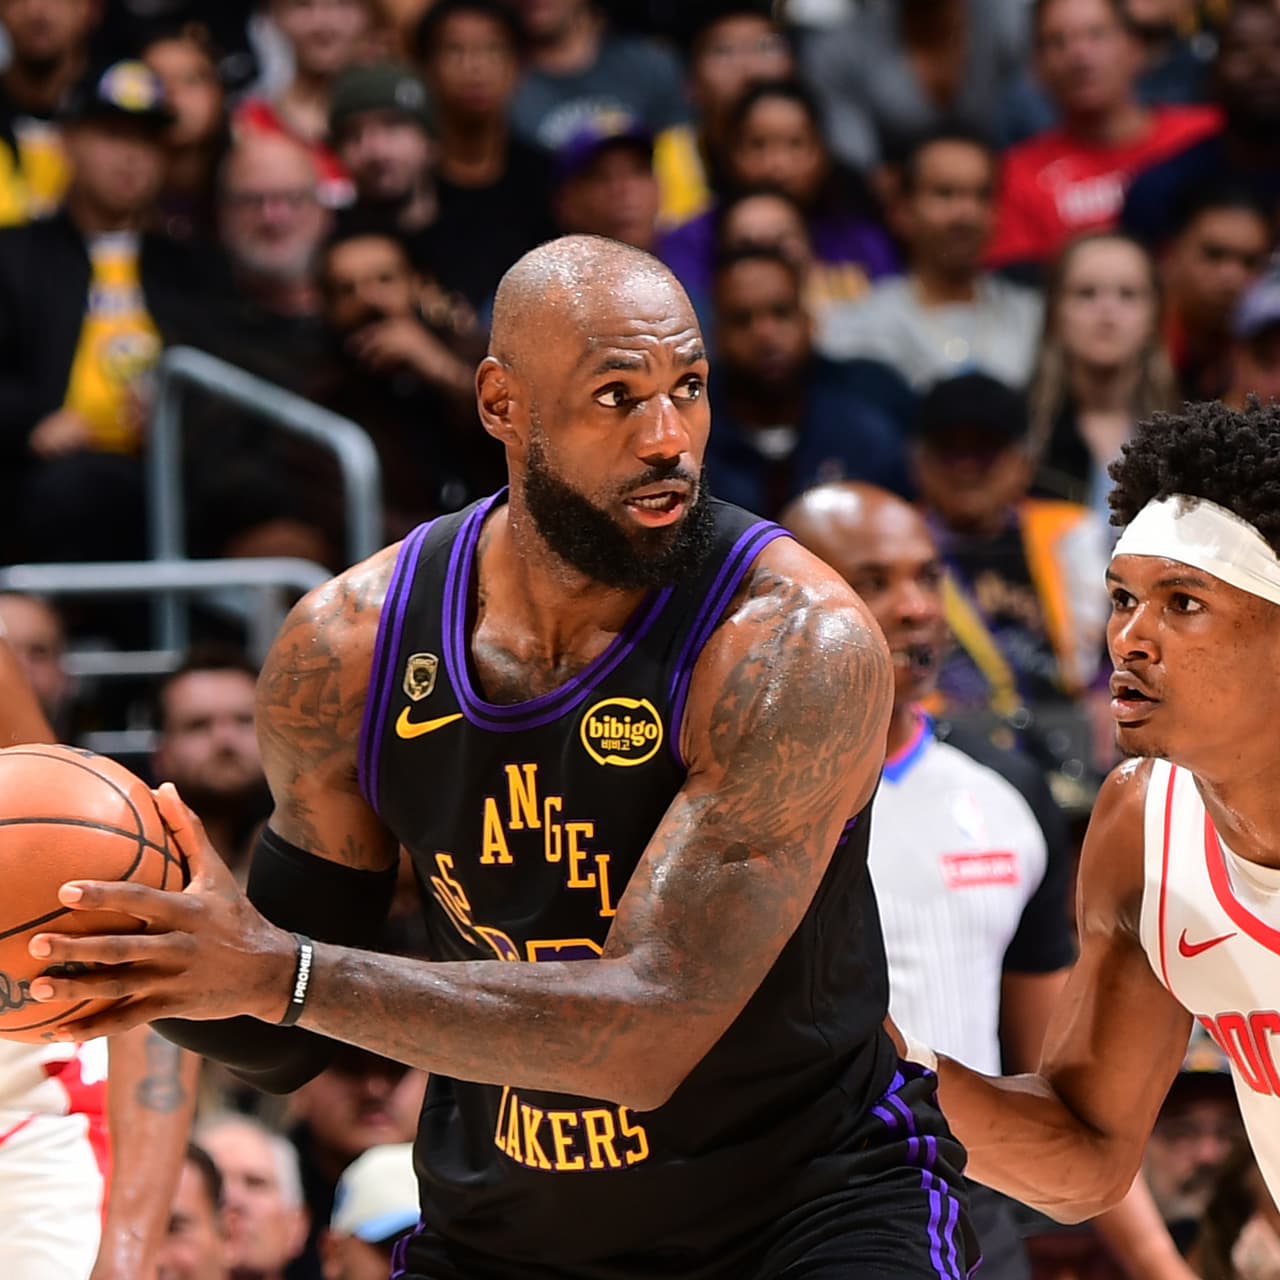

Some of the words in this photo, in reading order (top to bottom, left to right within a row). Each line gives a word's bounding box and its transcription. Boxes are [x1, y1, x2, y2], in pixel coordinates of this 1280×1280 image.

[589, 715, 658, 747] bibigo
[479, 763, 618, 918] ANGEL
[495, 1084, 650, 1171] LAKERS
